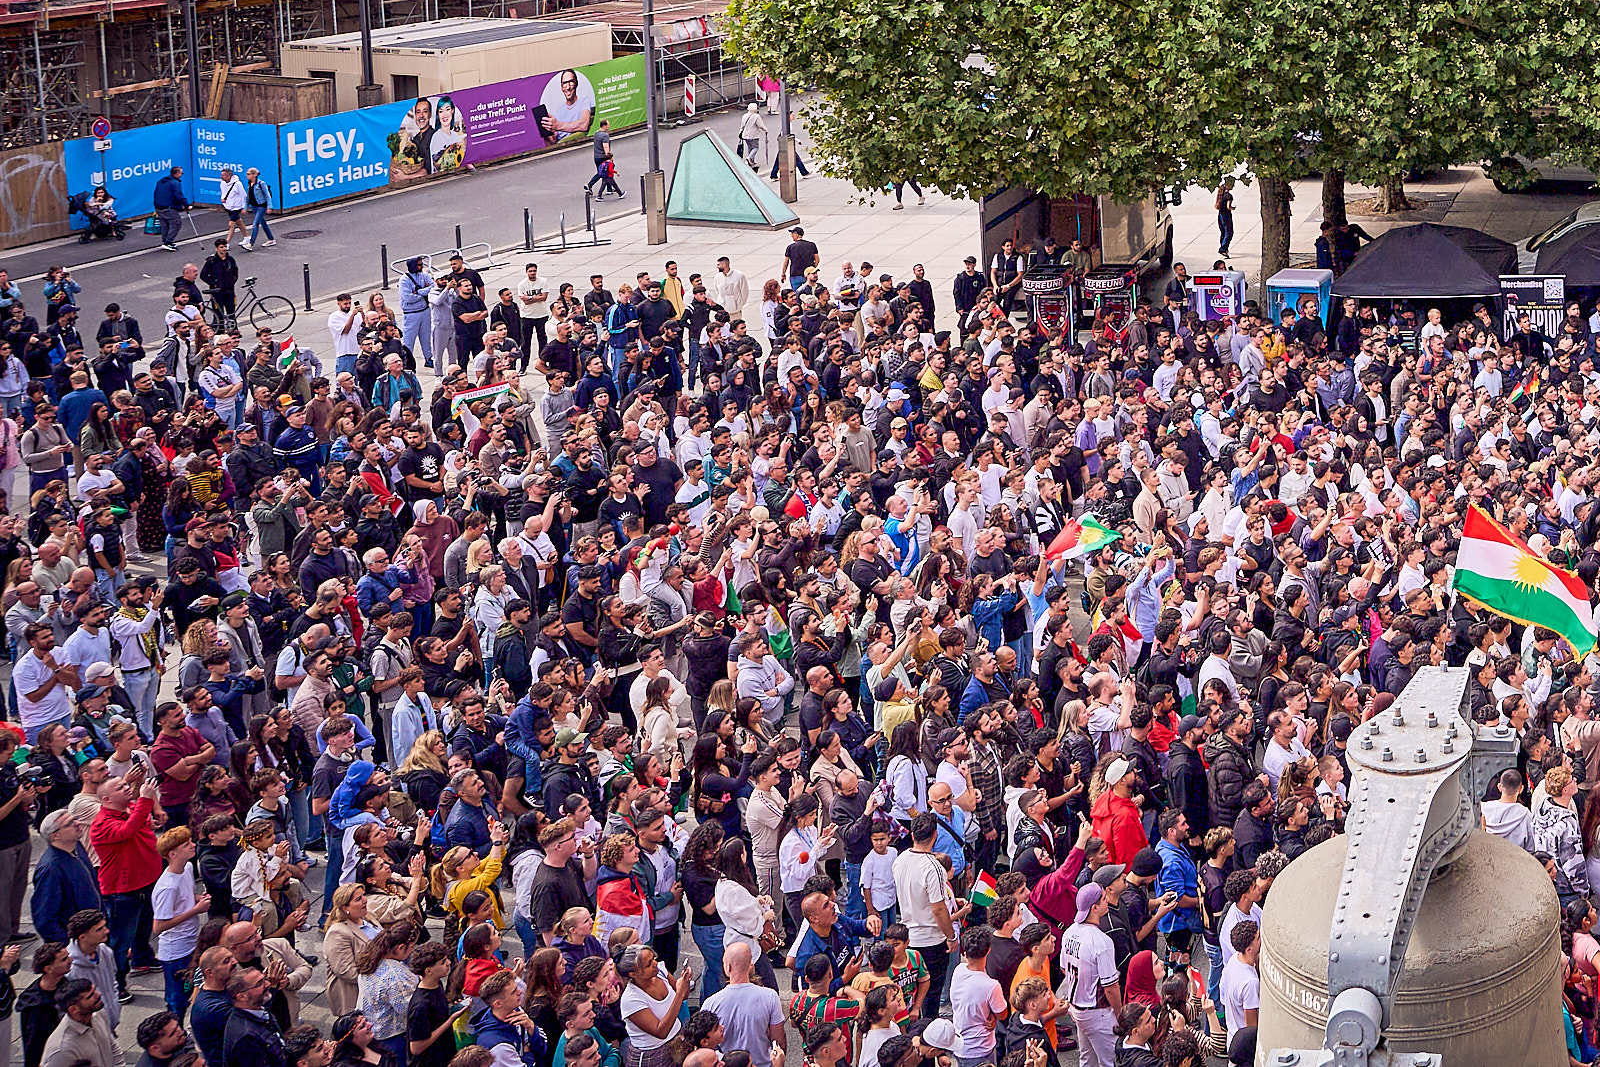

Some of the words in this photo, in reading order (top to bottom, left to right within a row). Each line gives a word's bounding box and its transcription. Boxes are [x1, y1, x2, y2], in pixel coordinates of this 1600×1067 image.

[612, 74, 622, 82] bist
[622, 71, 636, 80] mehr
[487, 99, 504, 109] wirst
[505, 97, 516, 106] der
[470, 112, 487, 122] neue
[488, 108, 506, 119] Treff.
[506, 104, 526, 115] Punkt
[197, 128, 226, 142] Haus
[198, 142, 217, 156] des
[287, 128, 364, 166] Hey,
[112, 158, 172, 182] BOCHUM
[198, 158, 244, 172] Wissens
[290, 172, 334, 194] altes
[338, 162, 388, 184] Haus,
[1500, 280, 1543, 288] Merchandise
[898, 970, 912, 980] TEK
[1300, 990, 1329, 1013] 1867
